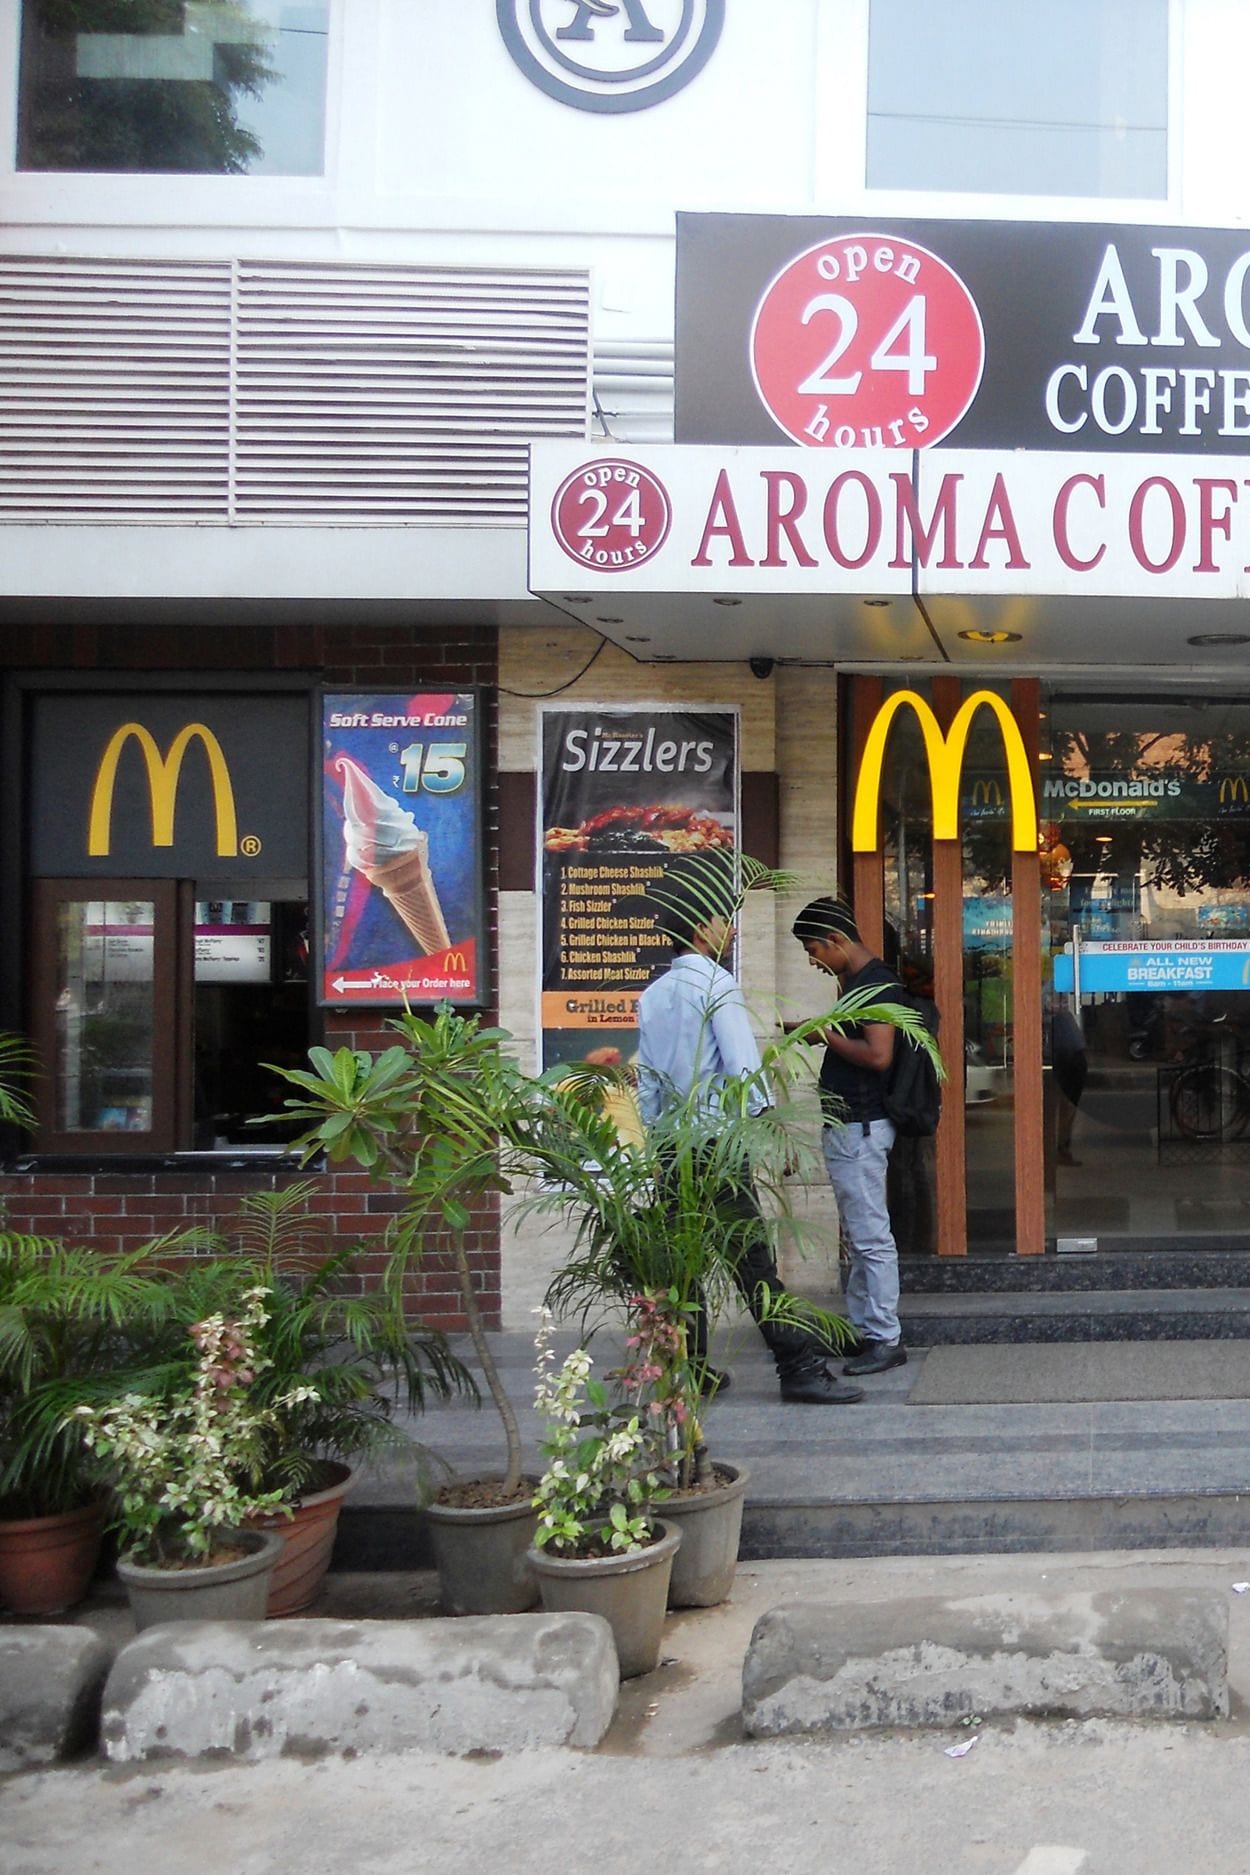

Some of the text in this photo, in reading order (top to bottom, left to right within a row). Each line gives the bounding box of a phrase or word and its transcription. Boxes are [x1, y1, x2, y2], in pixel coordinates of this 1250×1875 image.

[817, 245, 922, 284] open
[798, 293, 937, 395] 24
[805, 404, 929, 449] hours
[584, 467, 640, 488] open
[577, 489, 646, 536] 24
[691, 468, 1031, 570] AROMA
[580, 539, 648, 564] hours
[330, 713, 467, 728] Soft Serve Cone
[563, 727, 714, 772] Sizzlers
[400, 743, 467, 793] 15
[1044, 779, 1181, 798] McDonald's
[1111, 808, 1136, 816] FLOOR
[568, 866, 598, 879] Cottage
[599, 866, 628, 879] Cheese
[630, 866, 664, 879] Shashlik
[569, 884, 610, 895] Mushroom
[612, 884, 646, 895] Shashlik
[569, 901, 585, 912] Fish
[587, 901, 612, 912] Sizzler
[568, 917, 595, 929] Grilled
[597, 917, 628, 929] Chicken
[629, 917, 655, 929] Sizzler
[570, 934, 596, 946] Grilled
[597, 934, 628, 946] Chicken
[630, 934, 637, 946] in
[639, 934, 660, 946] Black
[662, 934, 674, 946] Pe
[1102, 943, 1148, 951] CELEBRATE
[1151, 943, 1173, 951] YOUR
[1175, 942, 1206, 951] CHILD'S
[1208, 942, 1247, 950] BIRTHDAY
[570, 951, 601, 963] Chicken
[603, 951, 636, 963] Shashlik
[1146, 957, 1213, 967] ALL NEW
[568, 969, 602, 980] Assorted
[604, 969, 624, 980] Meat
[625, 969, 650, 980] Sizzler
[1127, 966, 1213, 979] BREAKFAST
[423, 978, 448, 988] Order
[450, 978, 470, 987] here
[566, 999, 627, 1013] Grilled
[599, 1014, 635, 1023] Lemon
